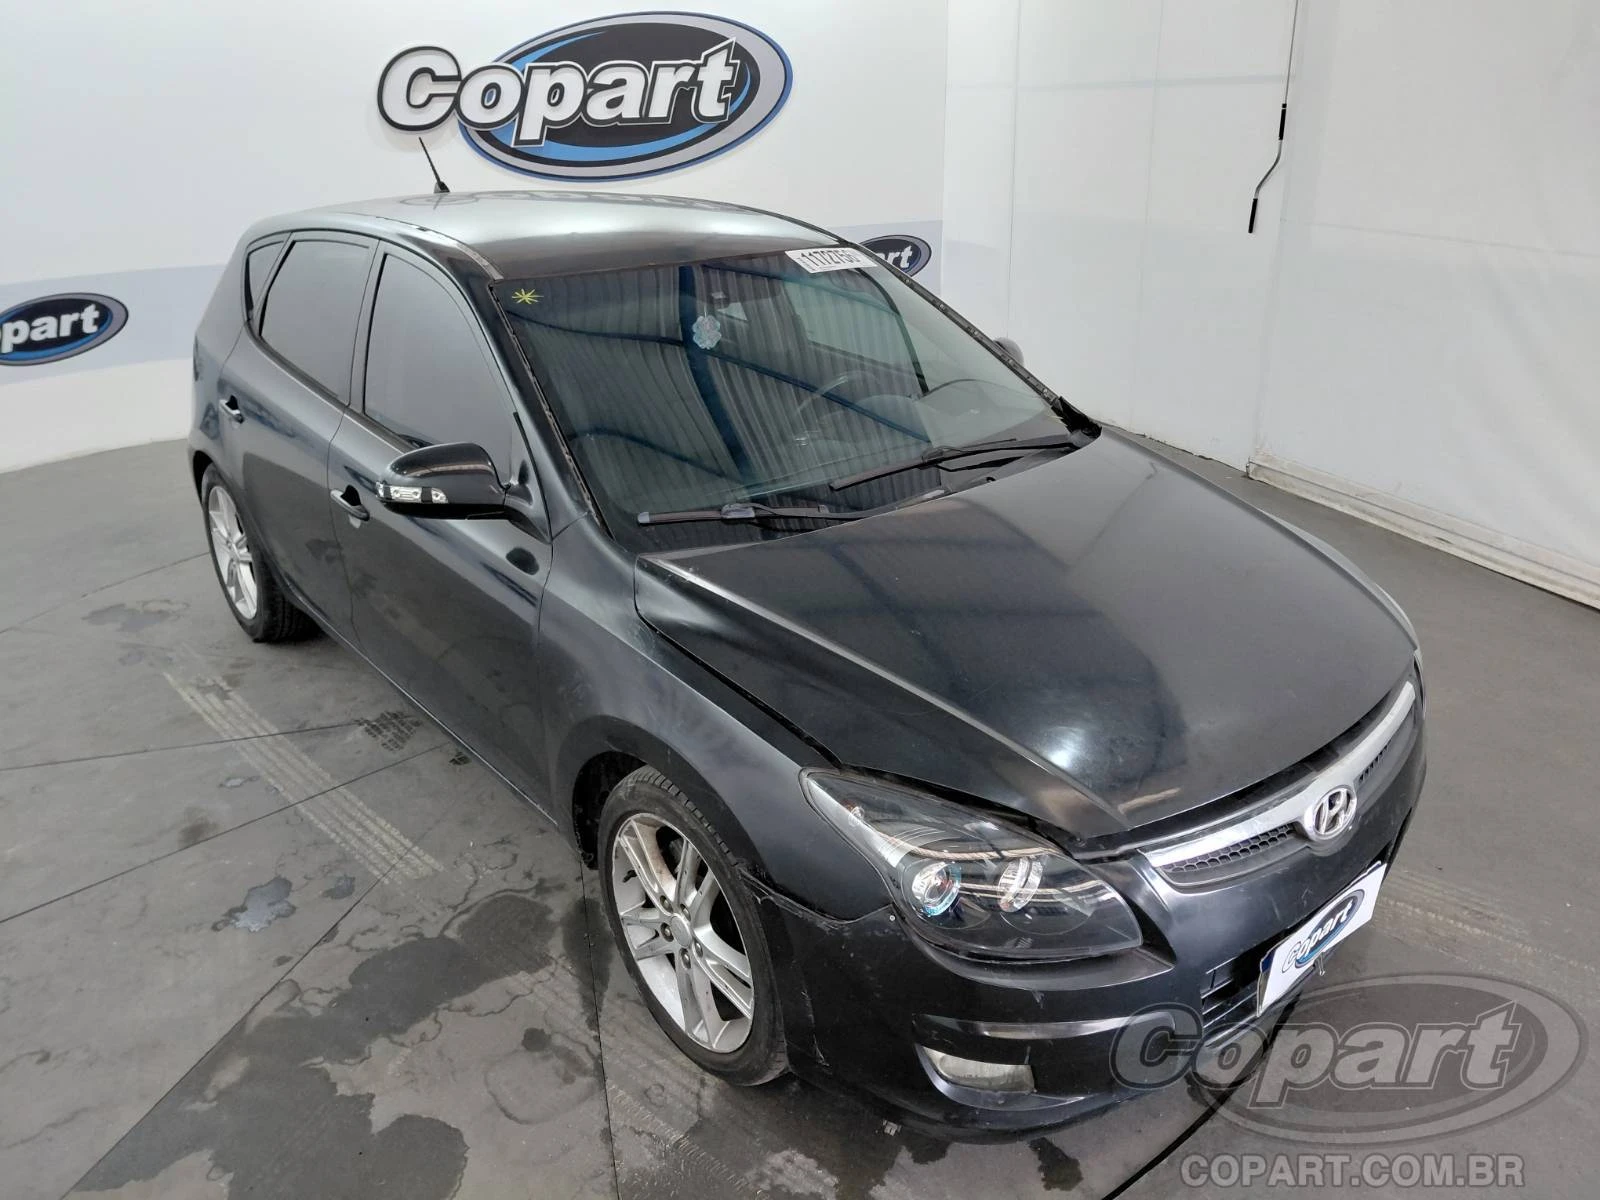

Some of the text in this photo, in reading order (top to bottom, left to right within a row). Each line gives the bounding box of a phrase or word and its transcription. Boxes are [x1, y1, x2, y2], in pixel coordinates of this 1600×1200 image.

[378, 38, 739, 147] Copart
[875, 246, 913, 268] rt
[0, 304, 100, 354] part
[1282, 898, 1354, 974] Copart
